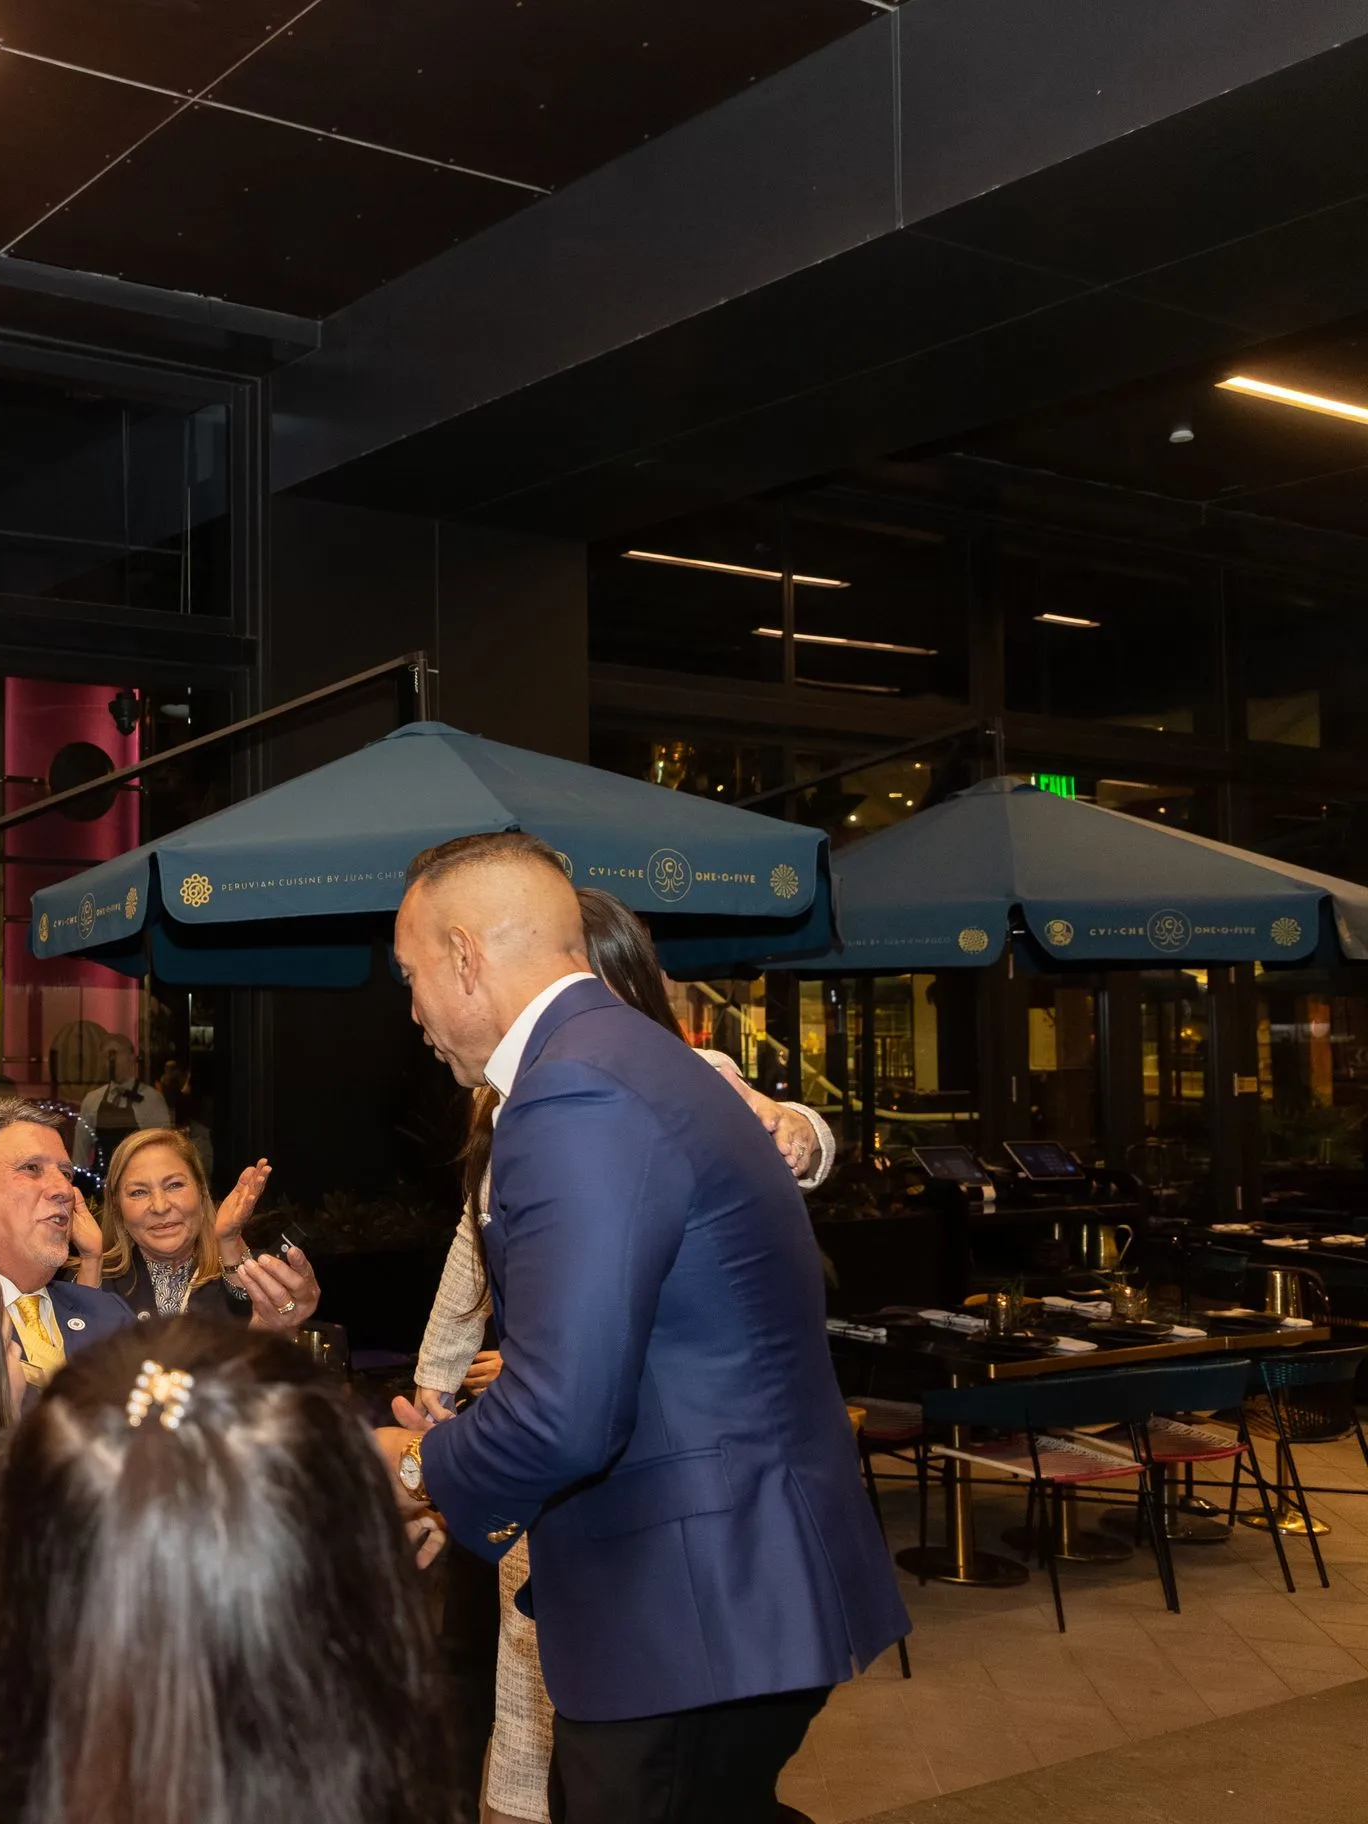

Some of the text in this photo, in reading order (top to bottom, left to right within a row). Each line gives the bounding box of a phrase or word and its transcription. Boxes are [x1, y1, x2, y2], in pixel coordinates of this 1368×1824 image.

[221, 880, 275, 892] PERUVIAN
[279, 876, 322, 887] CUISINE
[327, 874, 340, 883] BY
[344, 872, 373, 883] JUAN
